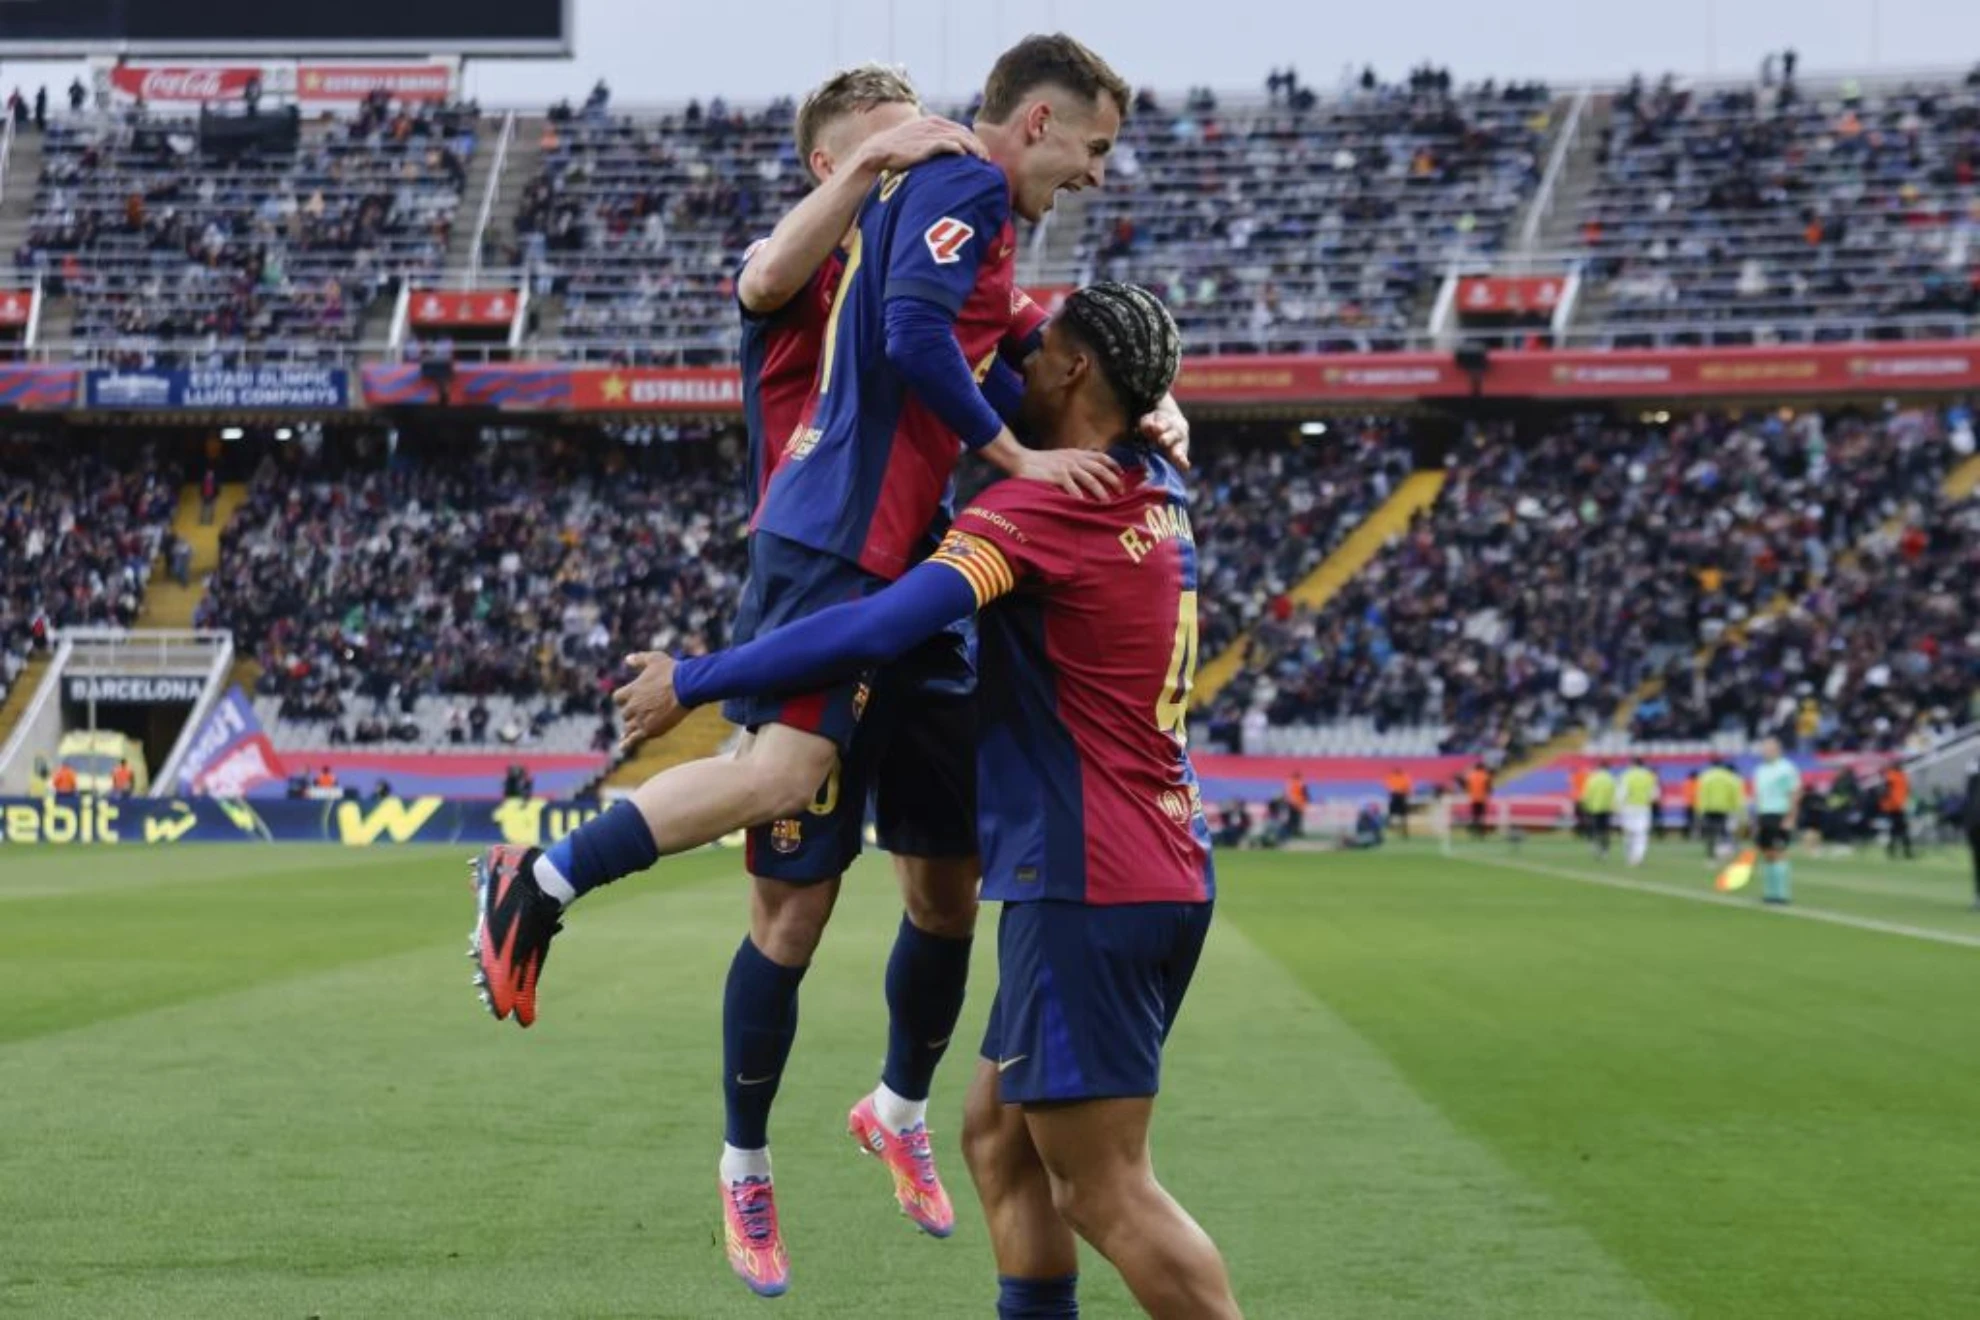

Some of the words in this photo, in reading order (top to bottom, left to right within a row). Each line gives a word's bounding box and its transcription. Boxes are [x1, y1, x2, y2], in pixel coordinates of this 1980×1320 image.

[631, 379, 733, 403] ESTRELLA
[1118, 526, 1153, 563] R.
[1156, 590, 1198, 748] 4
[70, 679, 202, 700] BARCELONA
[0, 795, 120, 843] ebit
